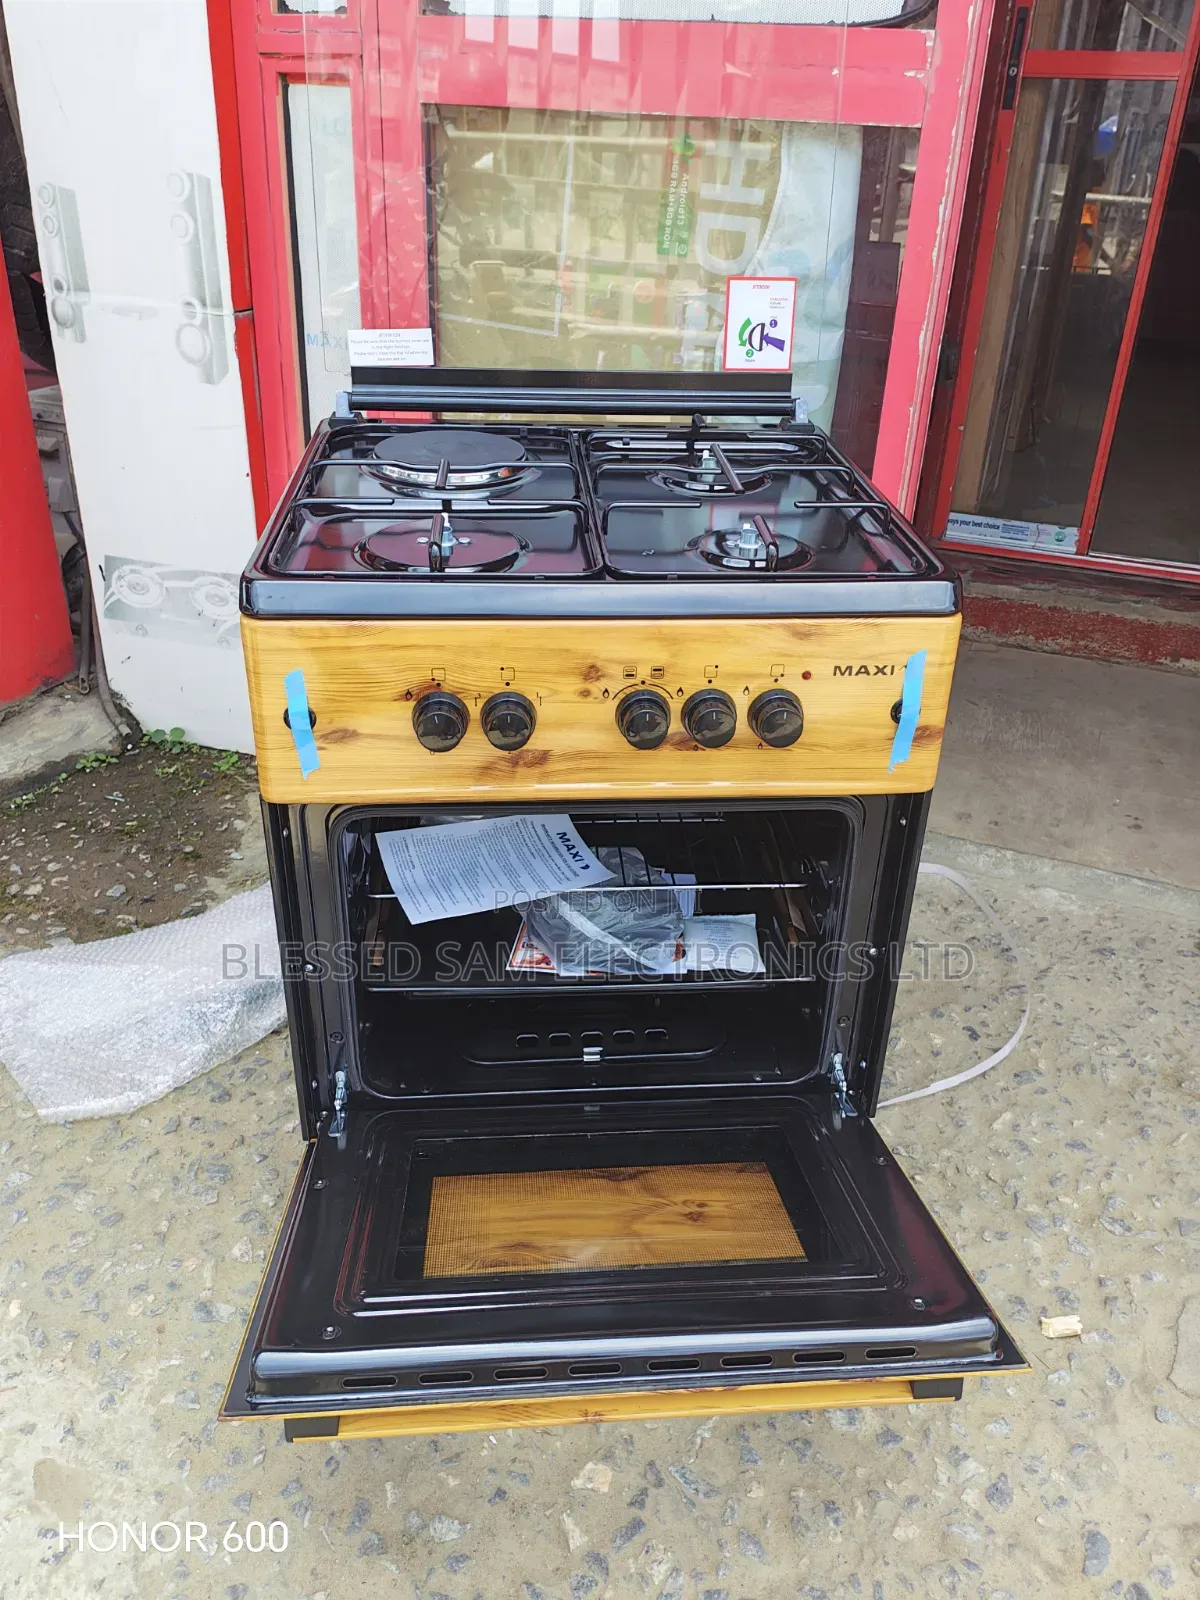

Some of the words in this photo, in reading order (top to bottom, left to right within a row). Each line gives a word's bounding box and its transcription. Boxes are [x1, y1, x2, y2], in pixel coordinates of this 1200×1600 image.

[677, 173, 689, 226] Android13
[972, 521, 983, 529] best
[984, 522, 1000, 530] choice
[833, 665, 895, 677] MAXI
[556, 831, 585, 863] MAXI
